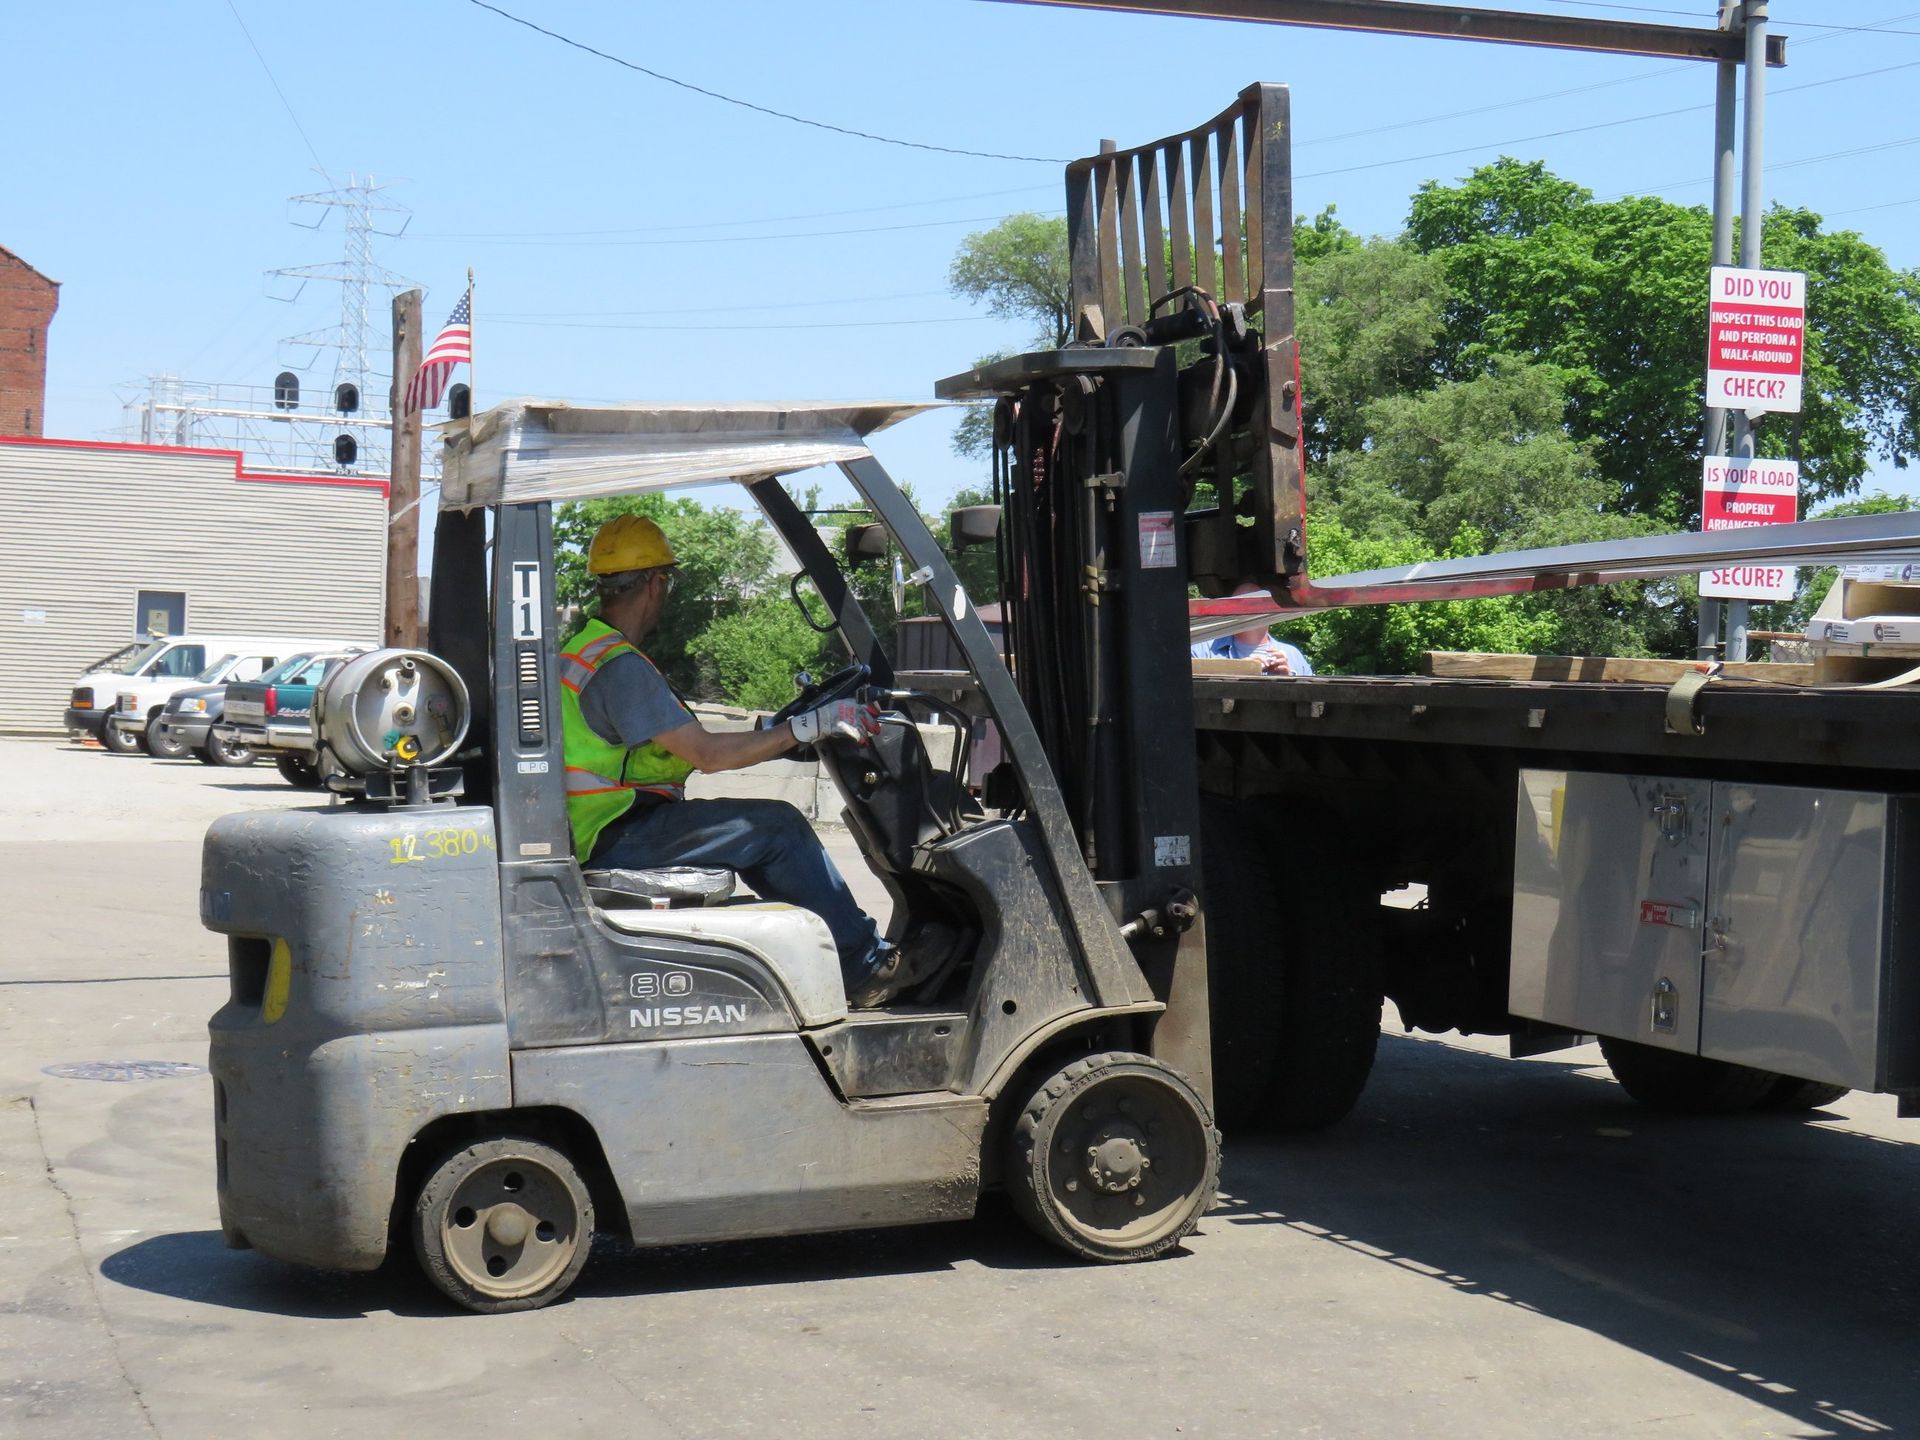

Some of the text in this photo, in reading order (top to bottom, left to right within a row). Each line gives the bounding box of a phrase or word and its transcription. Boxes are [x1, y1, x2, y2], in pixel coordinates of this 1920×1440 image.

[1724, 277, 1792, 300] DID YOU
[1712, 311, 1802, 329] INSPECT THIS LOAD
[1718, 330, 1796, 346] AND PERFORM A
[1721, 347, 1793, 364] WALK-AROUND
[1723, 377, 1786, 399] CHECK?
[1707, 467, 1795, 487] IS YOUR LOAD
[1726, 501, 1775, 515] PROPERLY
[1711, 566, 1784, 588] SECURE?
[520, 762, 547, 772] LPG
[630, 971, 693, 998] 80
[630, 1003, 746, 1028] NISSAN
